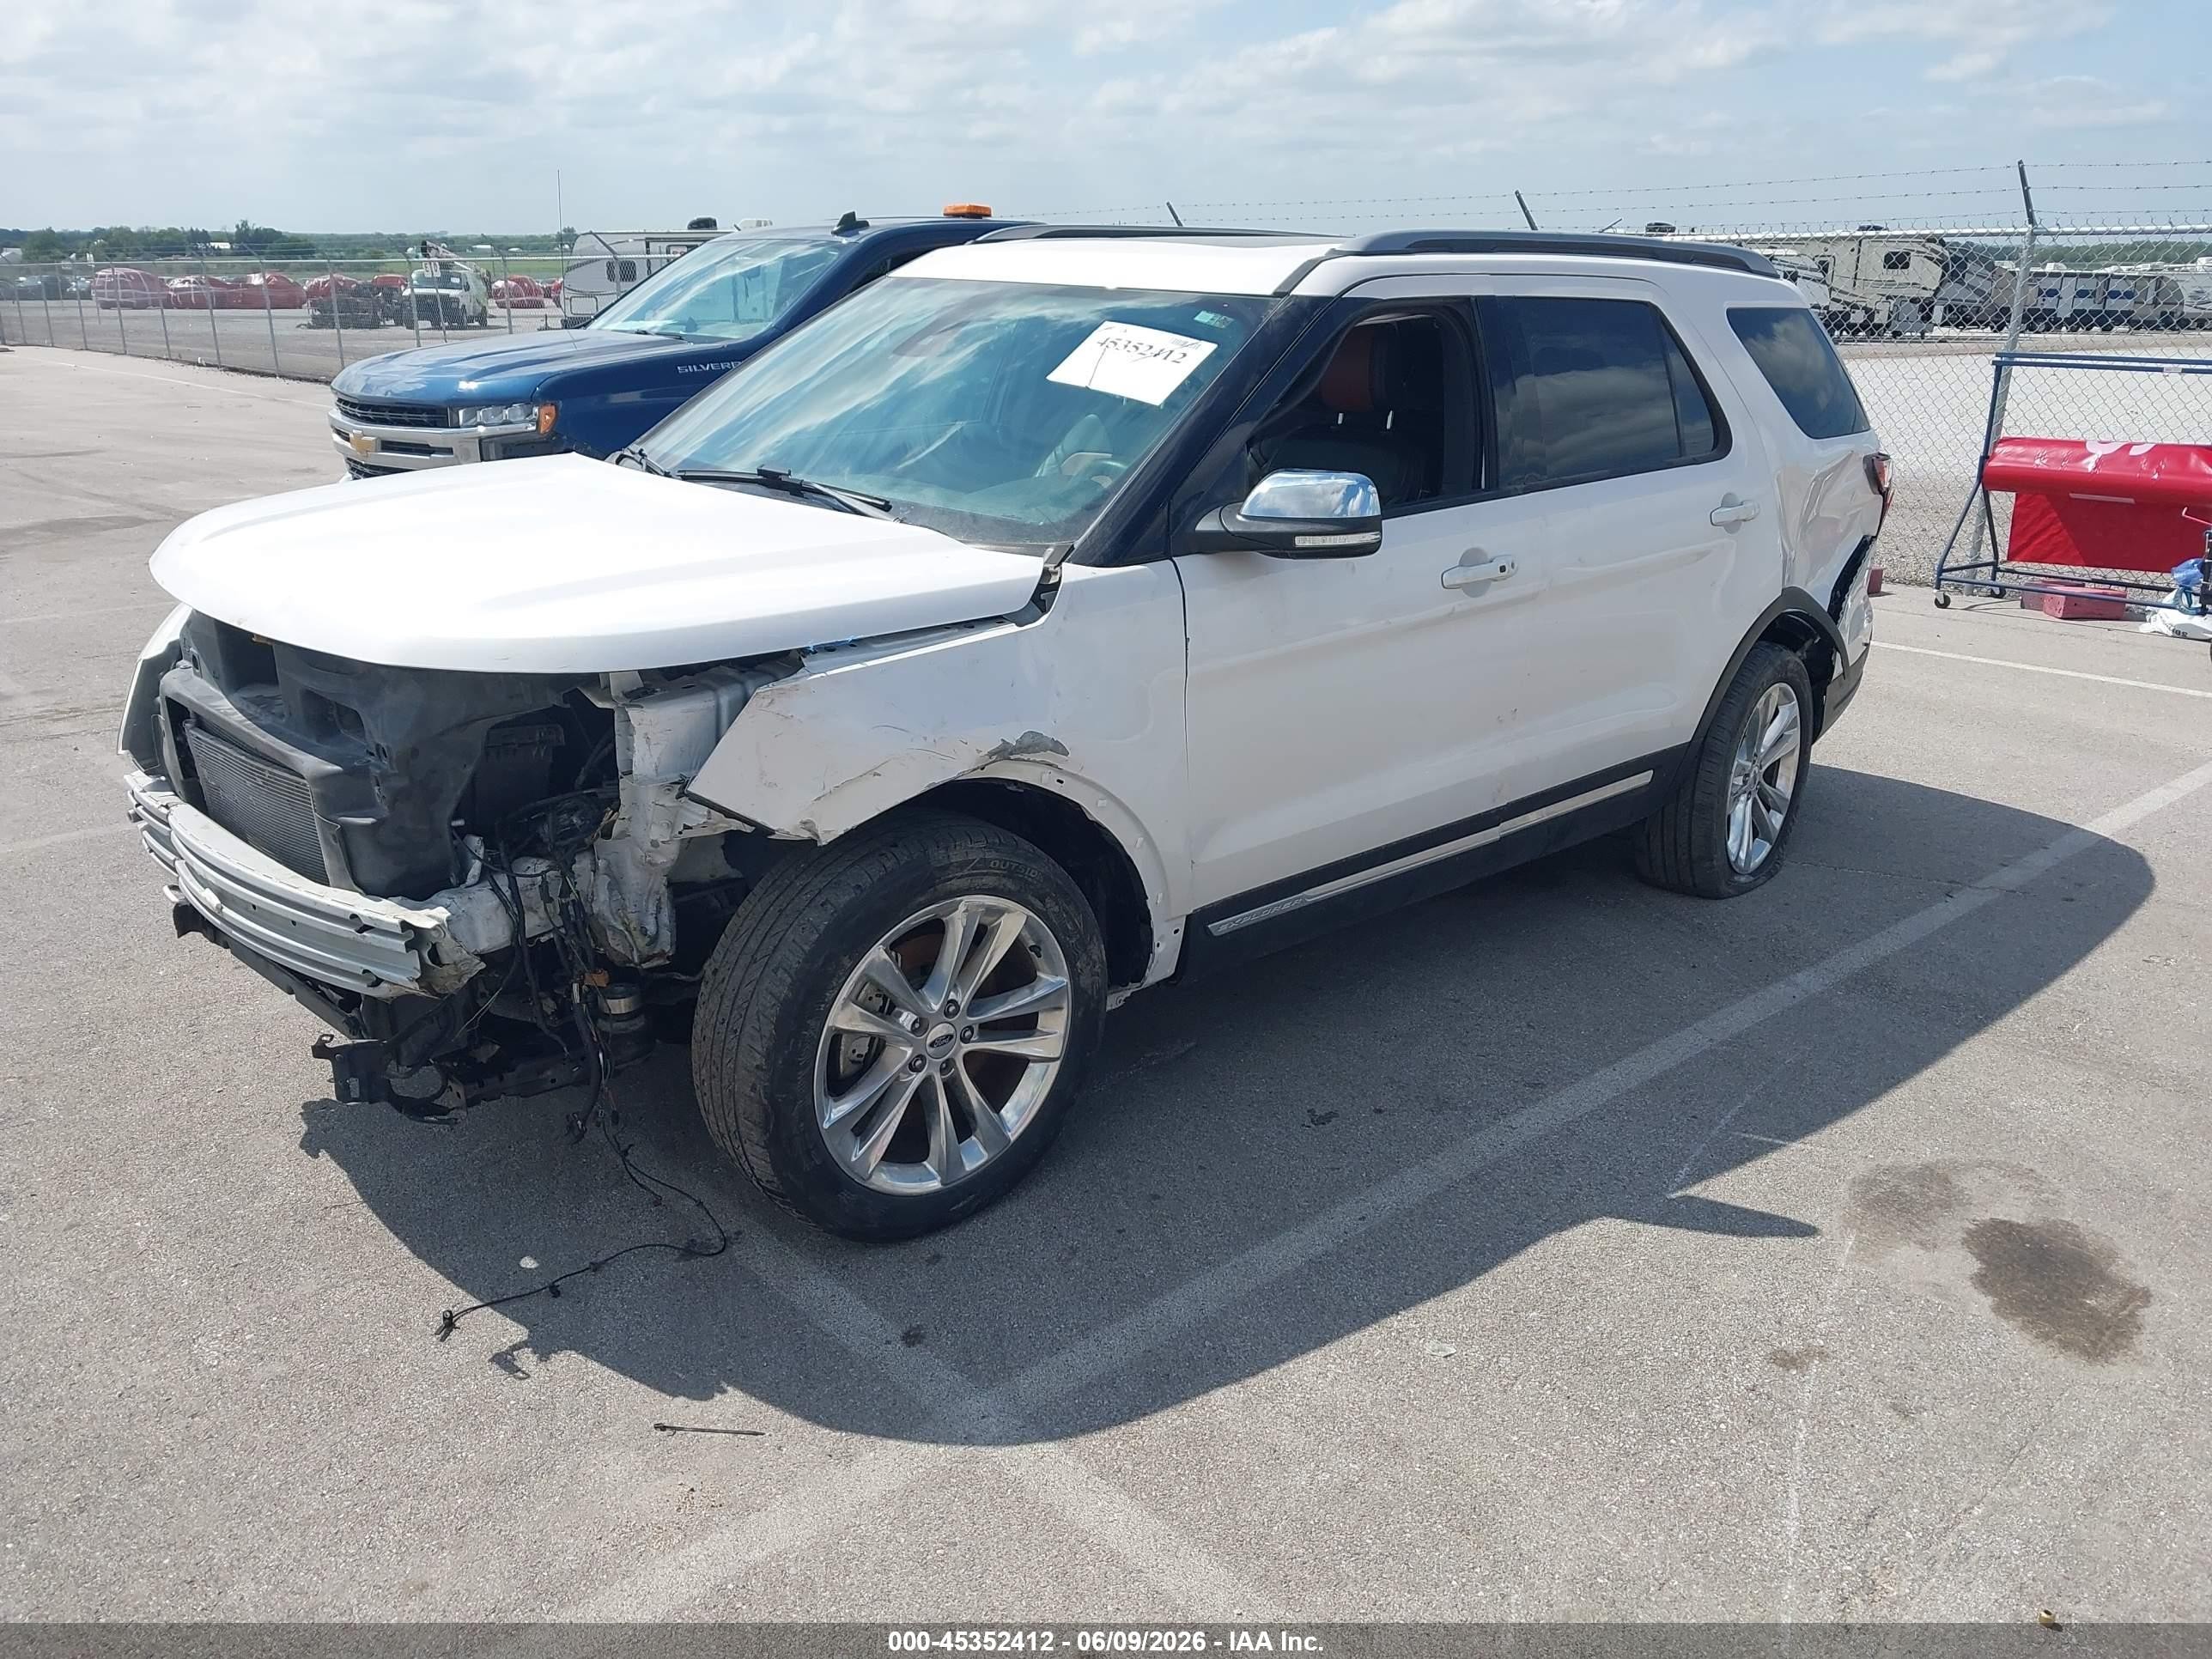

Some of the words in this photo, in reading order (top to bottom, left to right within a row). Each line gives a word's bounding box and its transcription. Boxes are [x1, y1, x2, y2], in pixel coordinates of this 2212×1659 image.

[1097, 337, 1188, 364] 45352412
[1217, 896, 1305, 933] EXPLORER
[933, 1036, 951, 1048] Ford
